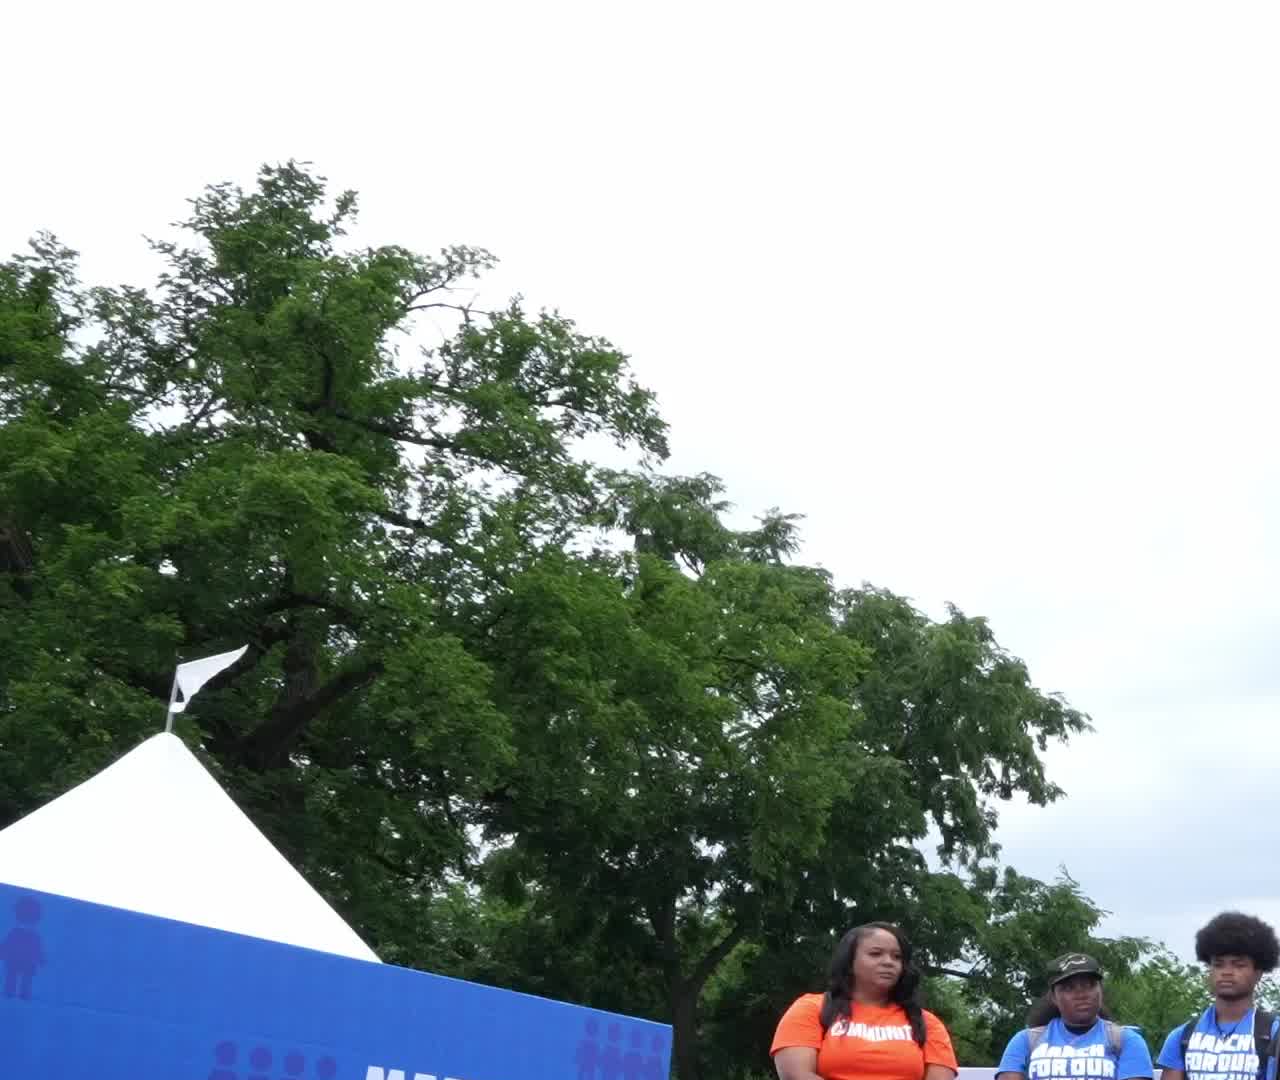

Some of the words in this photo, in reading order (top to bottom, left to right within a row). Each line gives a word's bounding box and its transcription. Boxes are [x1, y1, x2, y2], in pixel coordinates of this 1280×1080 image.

[1028, 1058, 1067, 1079] FOR
[1070, 1058, 1115, 1079] OUR
[1218, 1053, 1259, 1073] OUR
